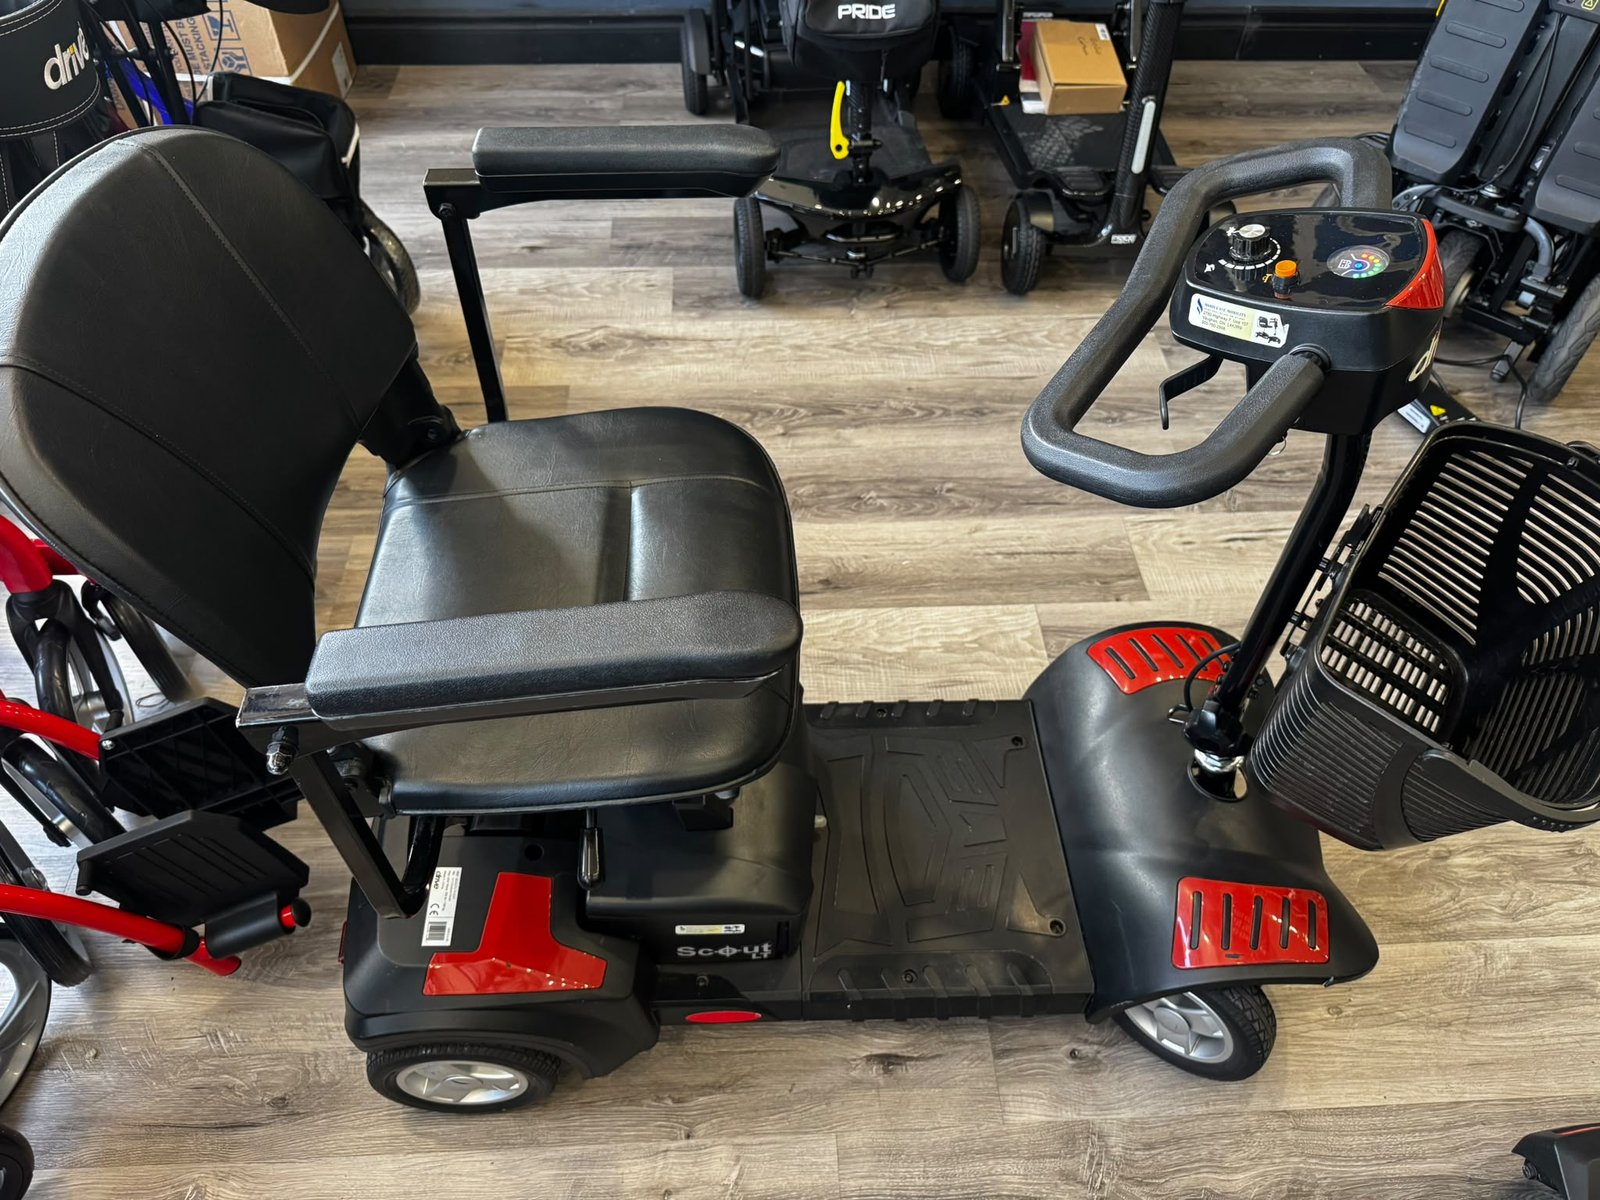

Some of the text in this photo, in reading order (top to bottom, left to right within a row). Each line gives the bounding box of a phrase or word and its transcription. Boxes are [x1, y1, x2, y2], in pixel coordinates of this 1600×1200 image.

[838, 4, 896, 19] PRIDE
[44, 21, 90, 90] drive
[180, 32, 197, 60] MUST
[187, 17, 211, 70] STACKING
[433, 870, 442, 890] drive
[677, 943, 772, 957] Scout
